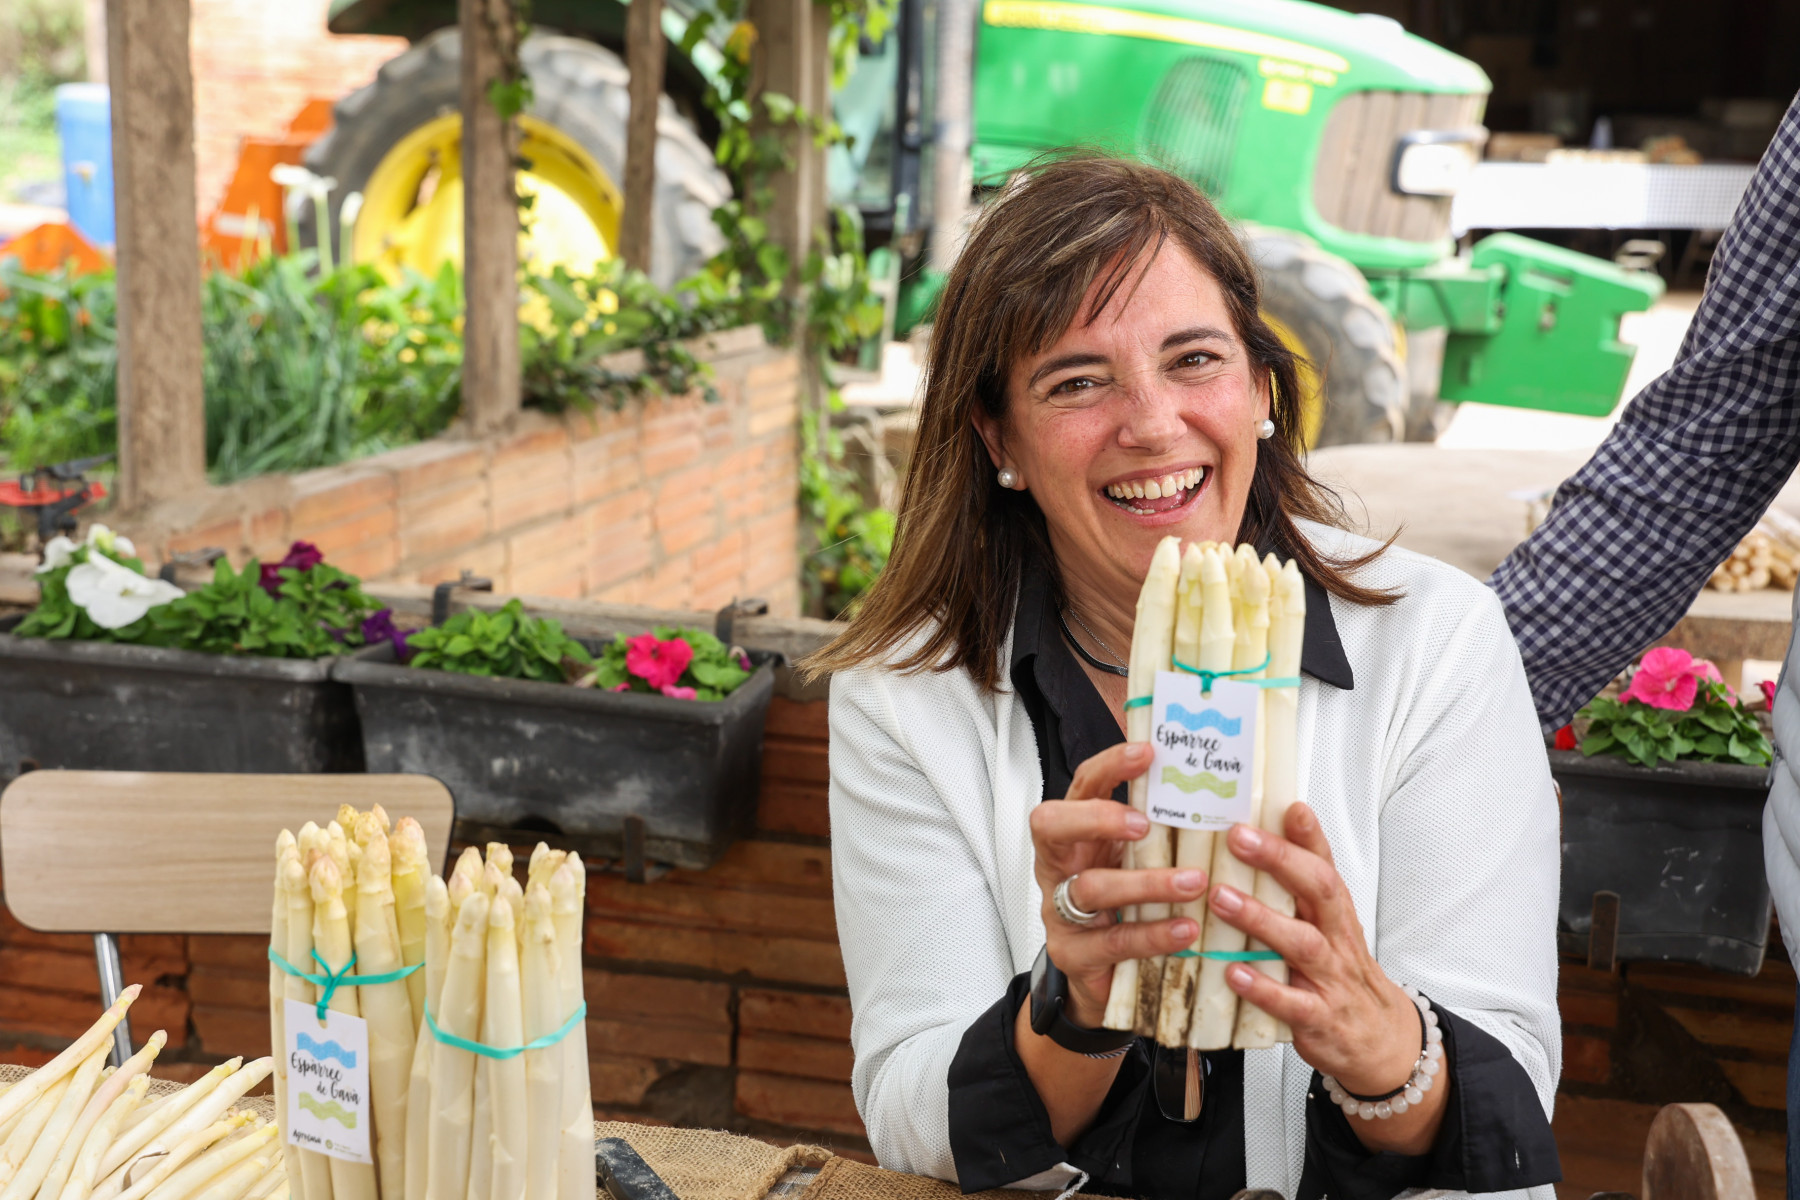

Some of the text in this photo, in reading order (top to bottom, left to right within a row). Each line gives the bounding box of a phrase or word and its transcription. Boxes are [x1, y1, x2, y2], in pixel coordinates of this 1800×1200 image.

[1185, 750, 1243, 774] de Gavà
[316, 1079, 361, 1105] de Gavà
